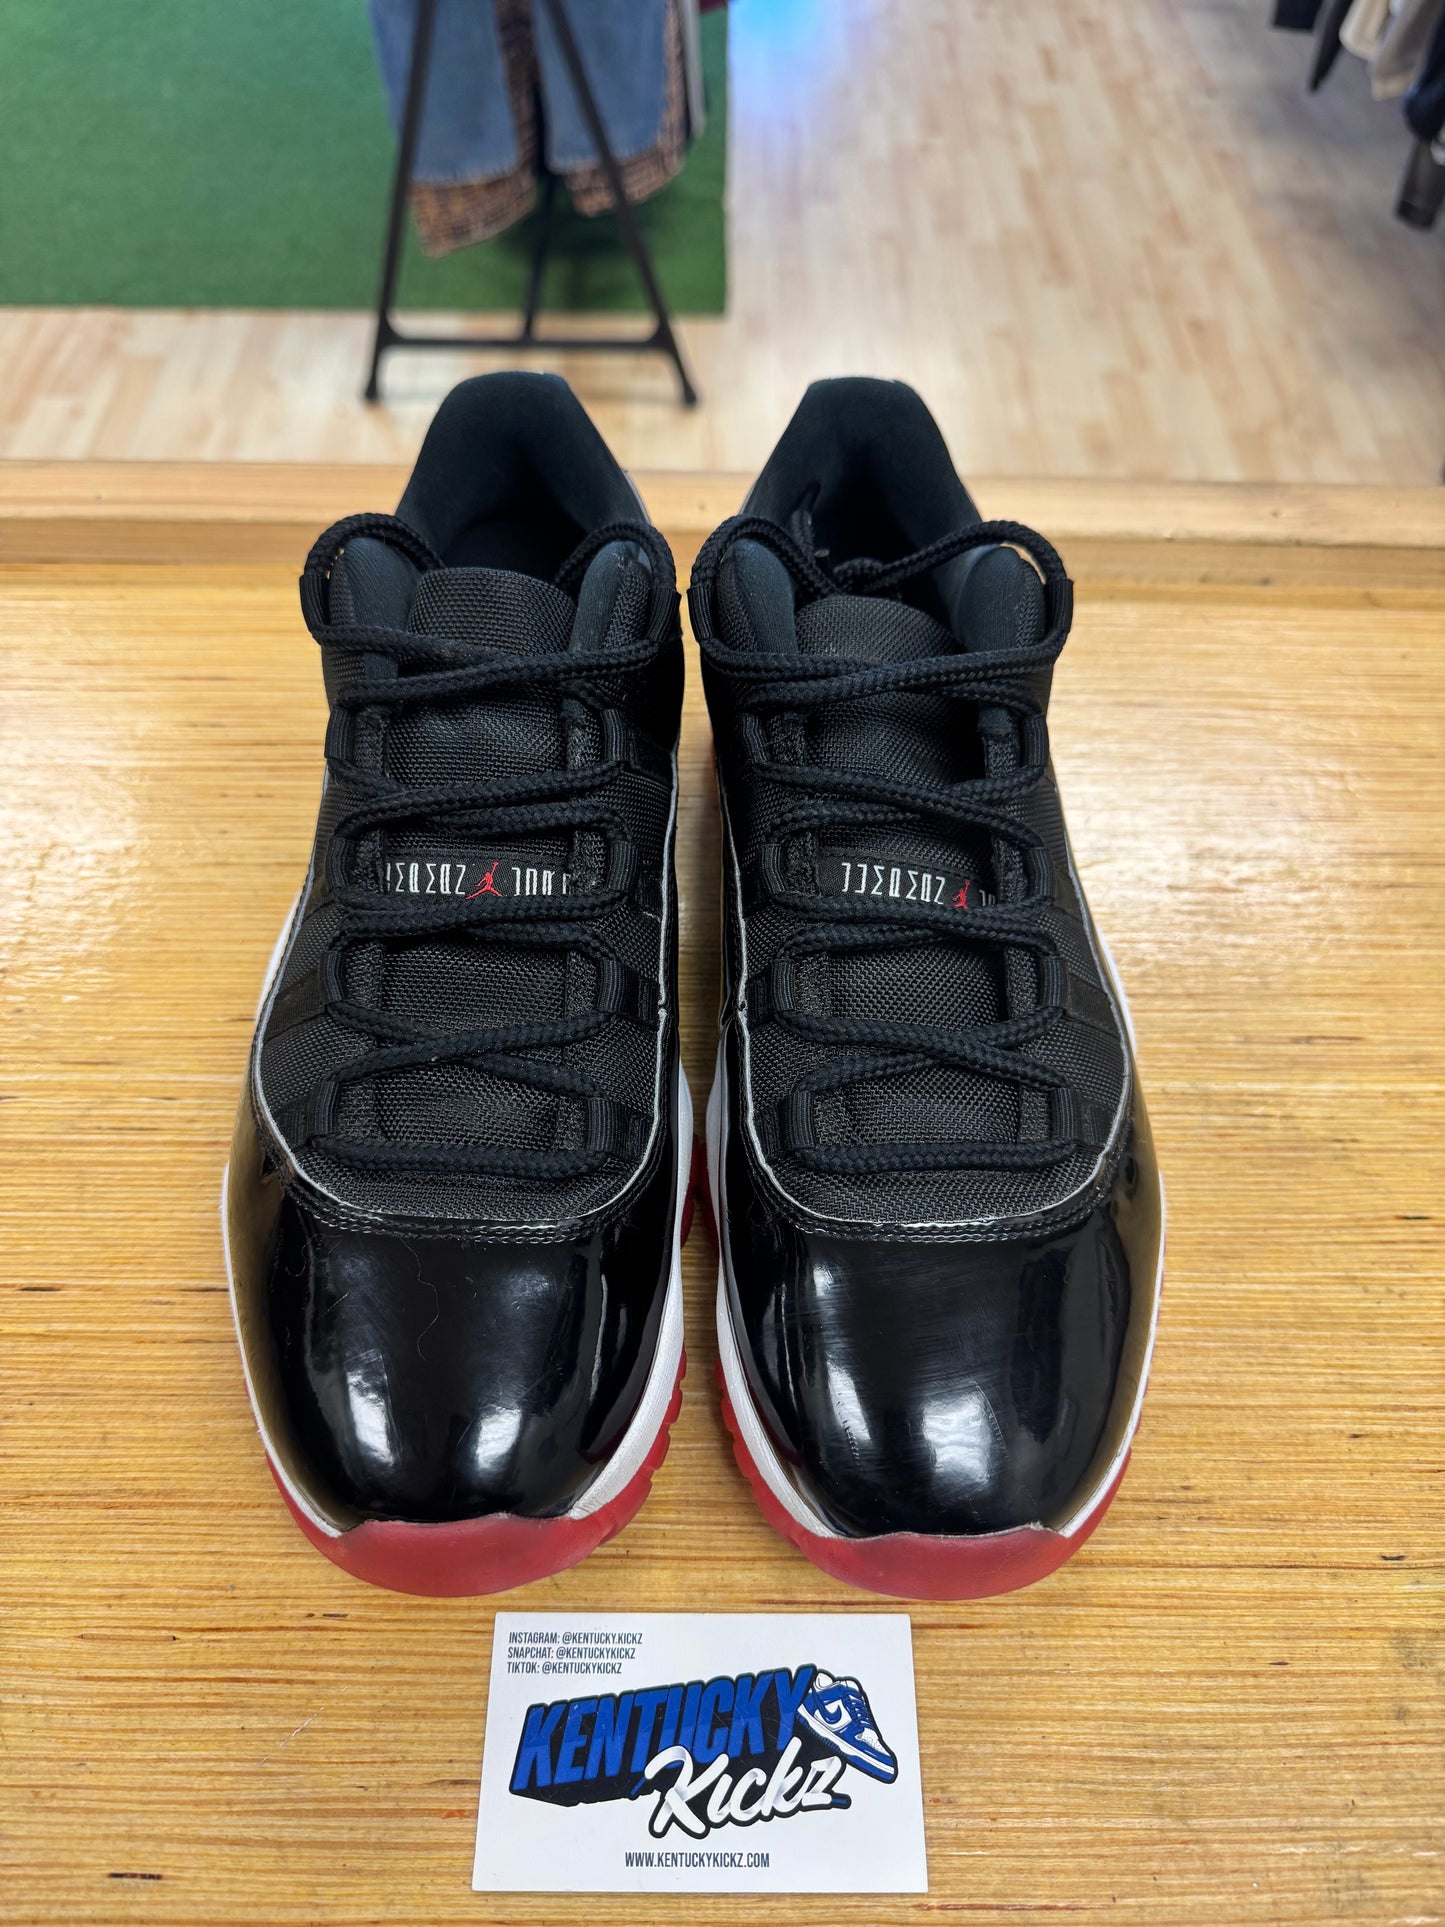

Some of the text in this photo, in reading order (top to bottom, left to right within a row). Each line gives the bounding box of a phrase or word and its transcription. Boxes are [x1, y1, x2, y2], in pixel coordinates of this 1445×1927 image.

[508, 1631, 643, 1645] INSTAGRAM: @KENTUCKY.KICKZ
[507, 1646, 636, 1660] SNAPCHAT: @KENTUCKYKICKZ
[506, 1661, 622, 1675] TIKTOK: @KENTUCKYKICKZ
[512, 1664, 815, 1792] KENTUCKY
[645, 1736, 843, 1834] Kickz
[625, 1851, 770, 1868] WWW.KENTUCKYKICKZ.COM
